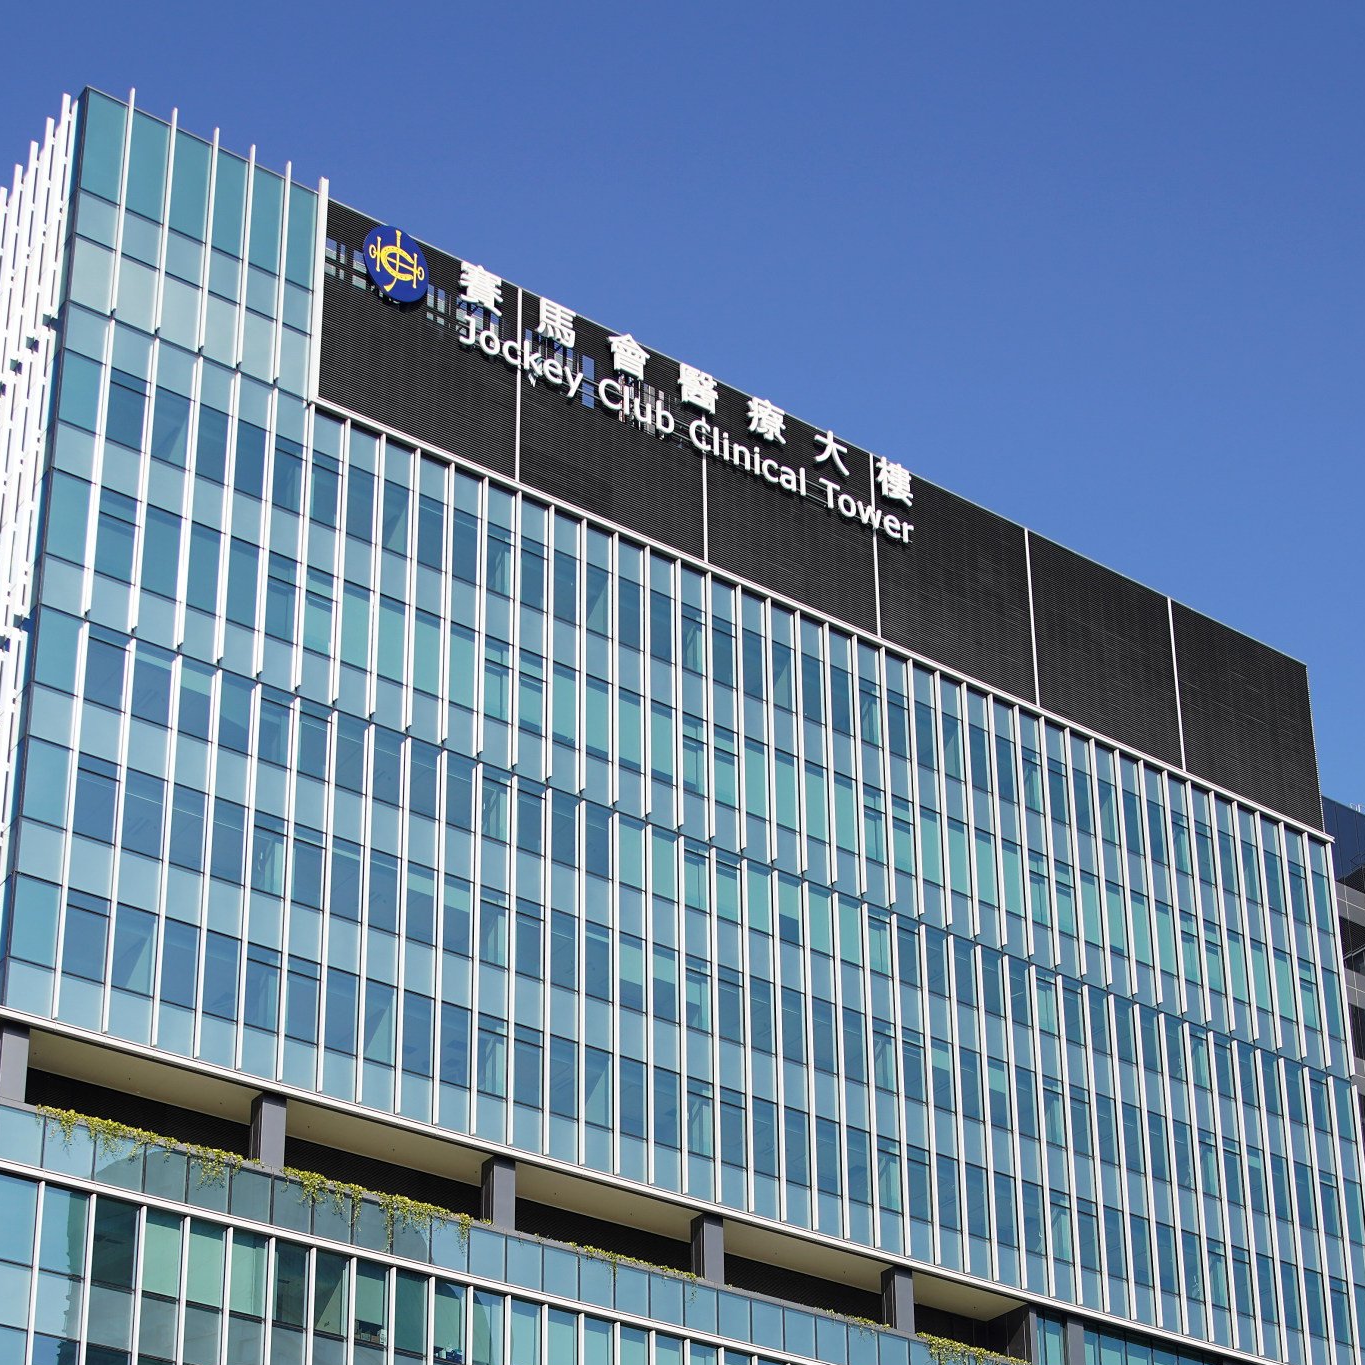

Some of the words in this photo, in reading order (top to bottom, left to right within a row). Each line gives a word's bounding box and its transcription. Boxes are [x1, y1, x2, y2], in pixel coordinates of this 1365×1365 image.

[459, 260, 914, 508] 賽馬會醫療大樓
[459, 315, 583, 398] Jockey
[599, 377, 675, 435] Club
[688, 418, 806, 497] Clinical
[819, 477, 914, 544] Tower
